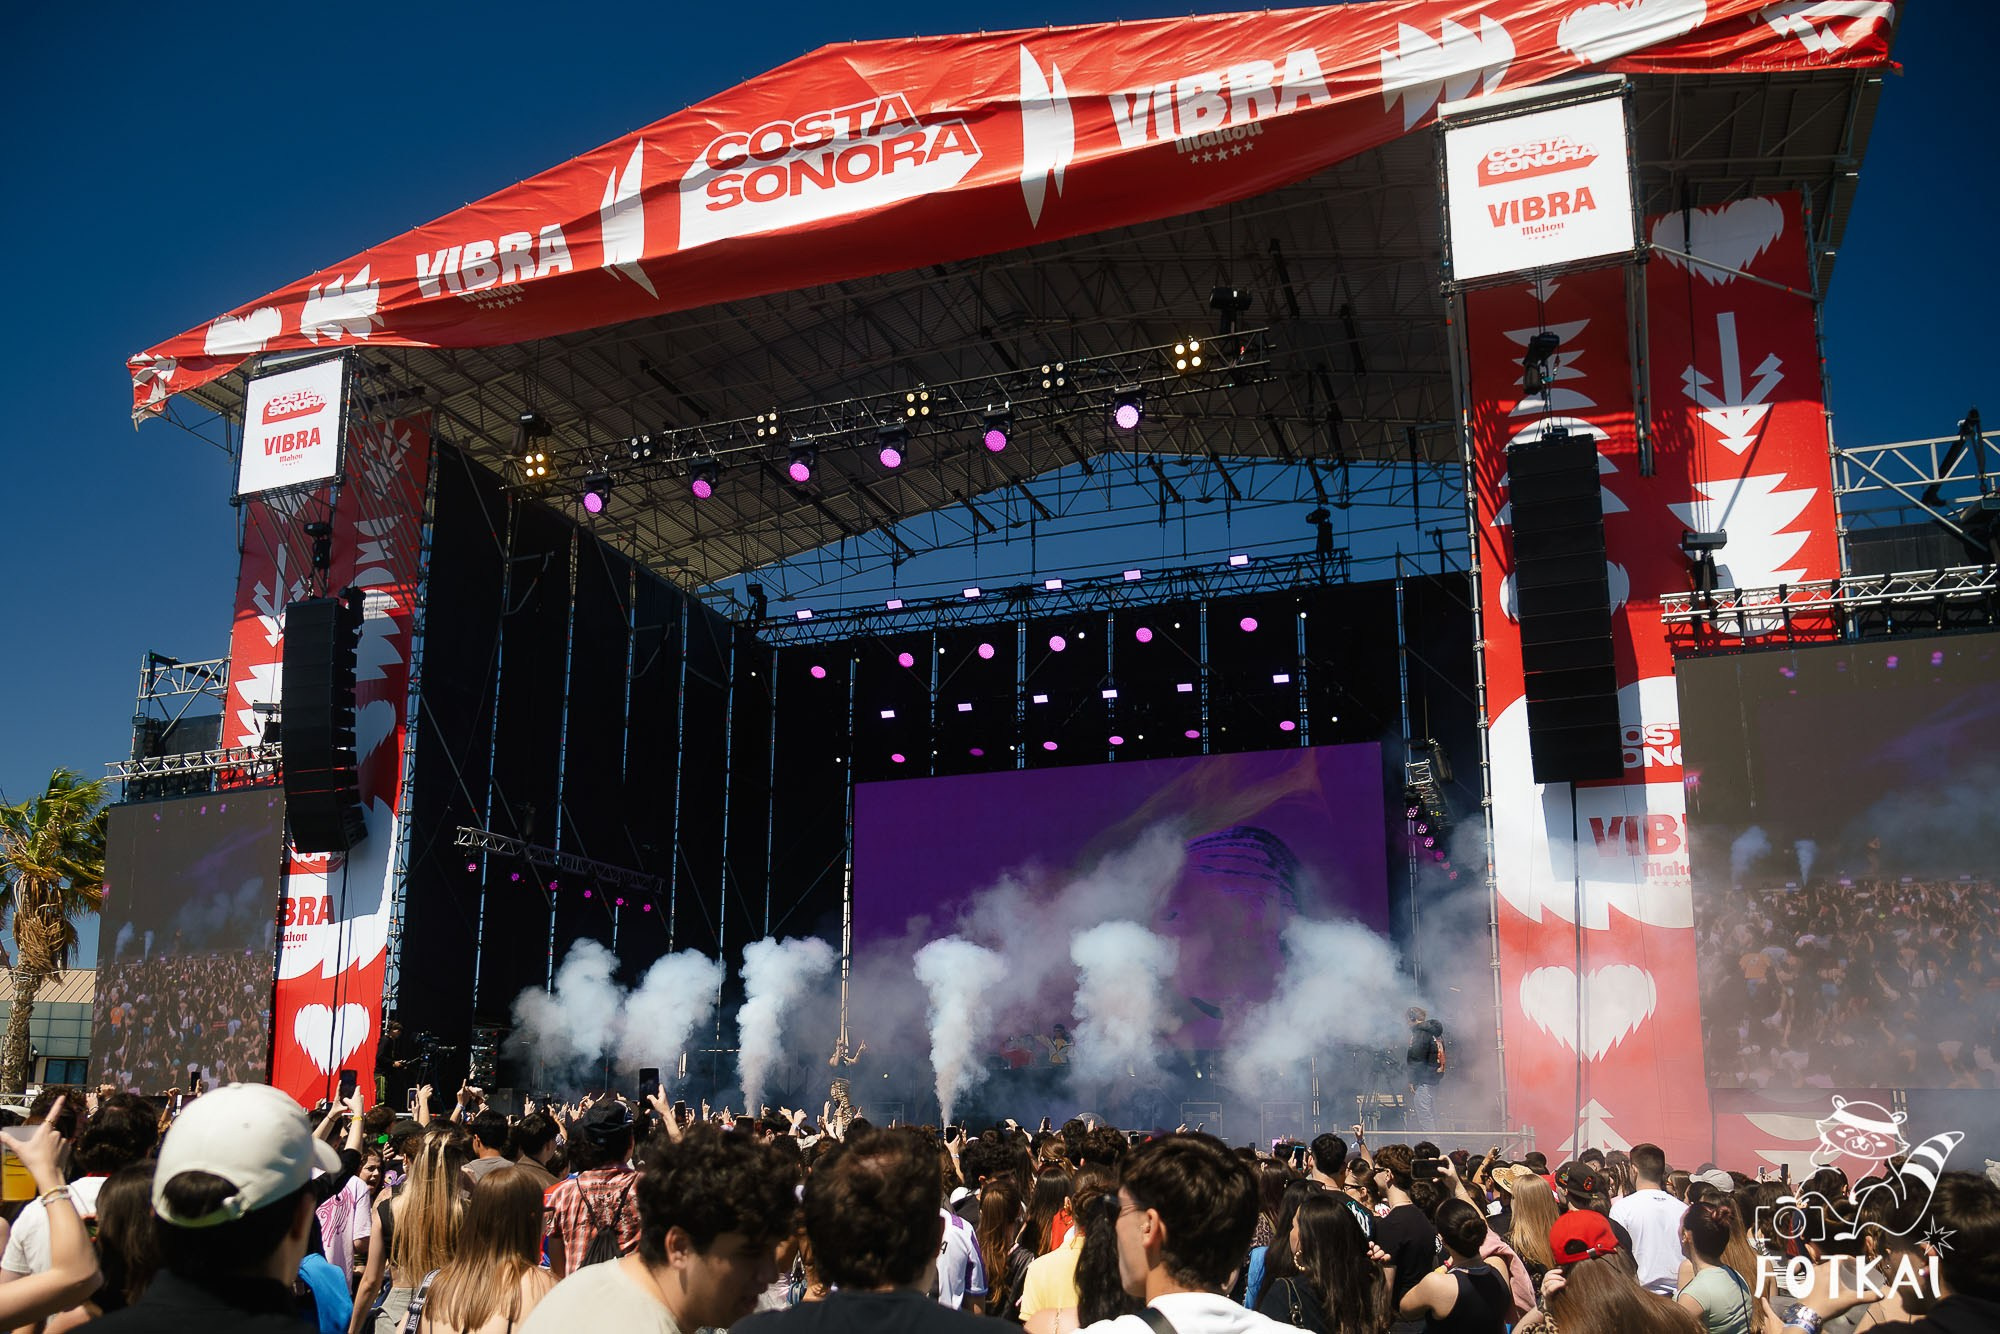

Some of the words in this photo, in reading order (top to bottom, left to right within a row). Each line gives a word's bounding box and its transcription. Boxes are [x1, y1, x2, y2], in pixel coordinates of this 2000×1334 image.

[1108, 48, 1332, 149] VIBRA
[705, 95, 916, 171] COSTA
[1487, 135, 1576, 162] COSTA
[705, 120, 979, 212] SONORA
[1487, 143, 1599, 176] SONORA
[1488, 187, 1597, 228] VIBRA
[1521, 222, 1565, 236] Mahou
[416, 223, 574, 299] VIBRA
[268, 395, 327, 417] SONORA
[270, 388, 314, 406] COSTA
[264, 427, 321, 456] VIBRA
[1588, 812, 1689, 858] VIB
[278, 895, 336, 927] BRA
[279, 931, 309, 942] ahou
